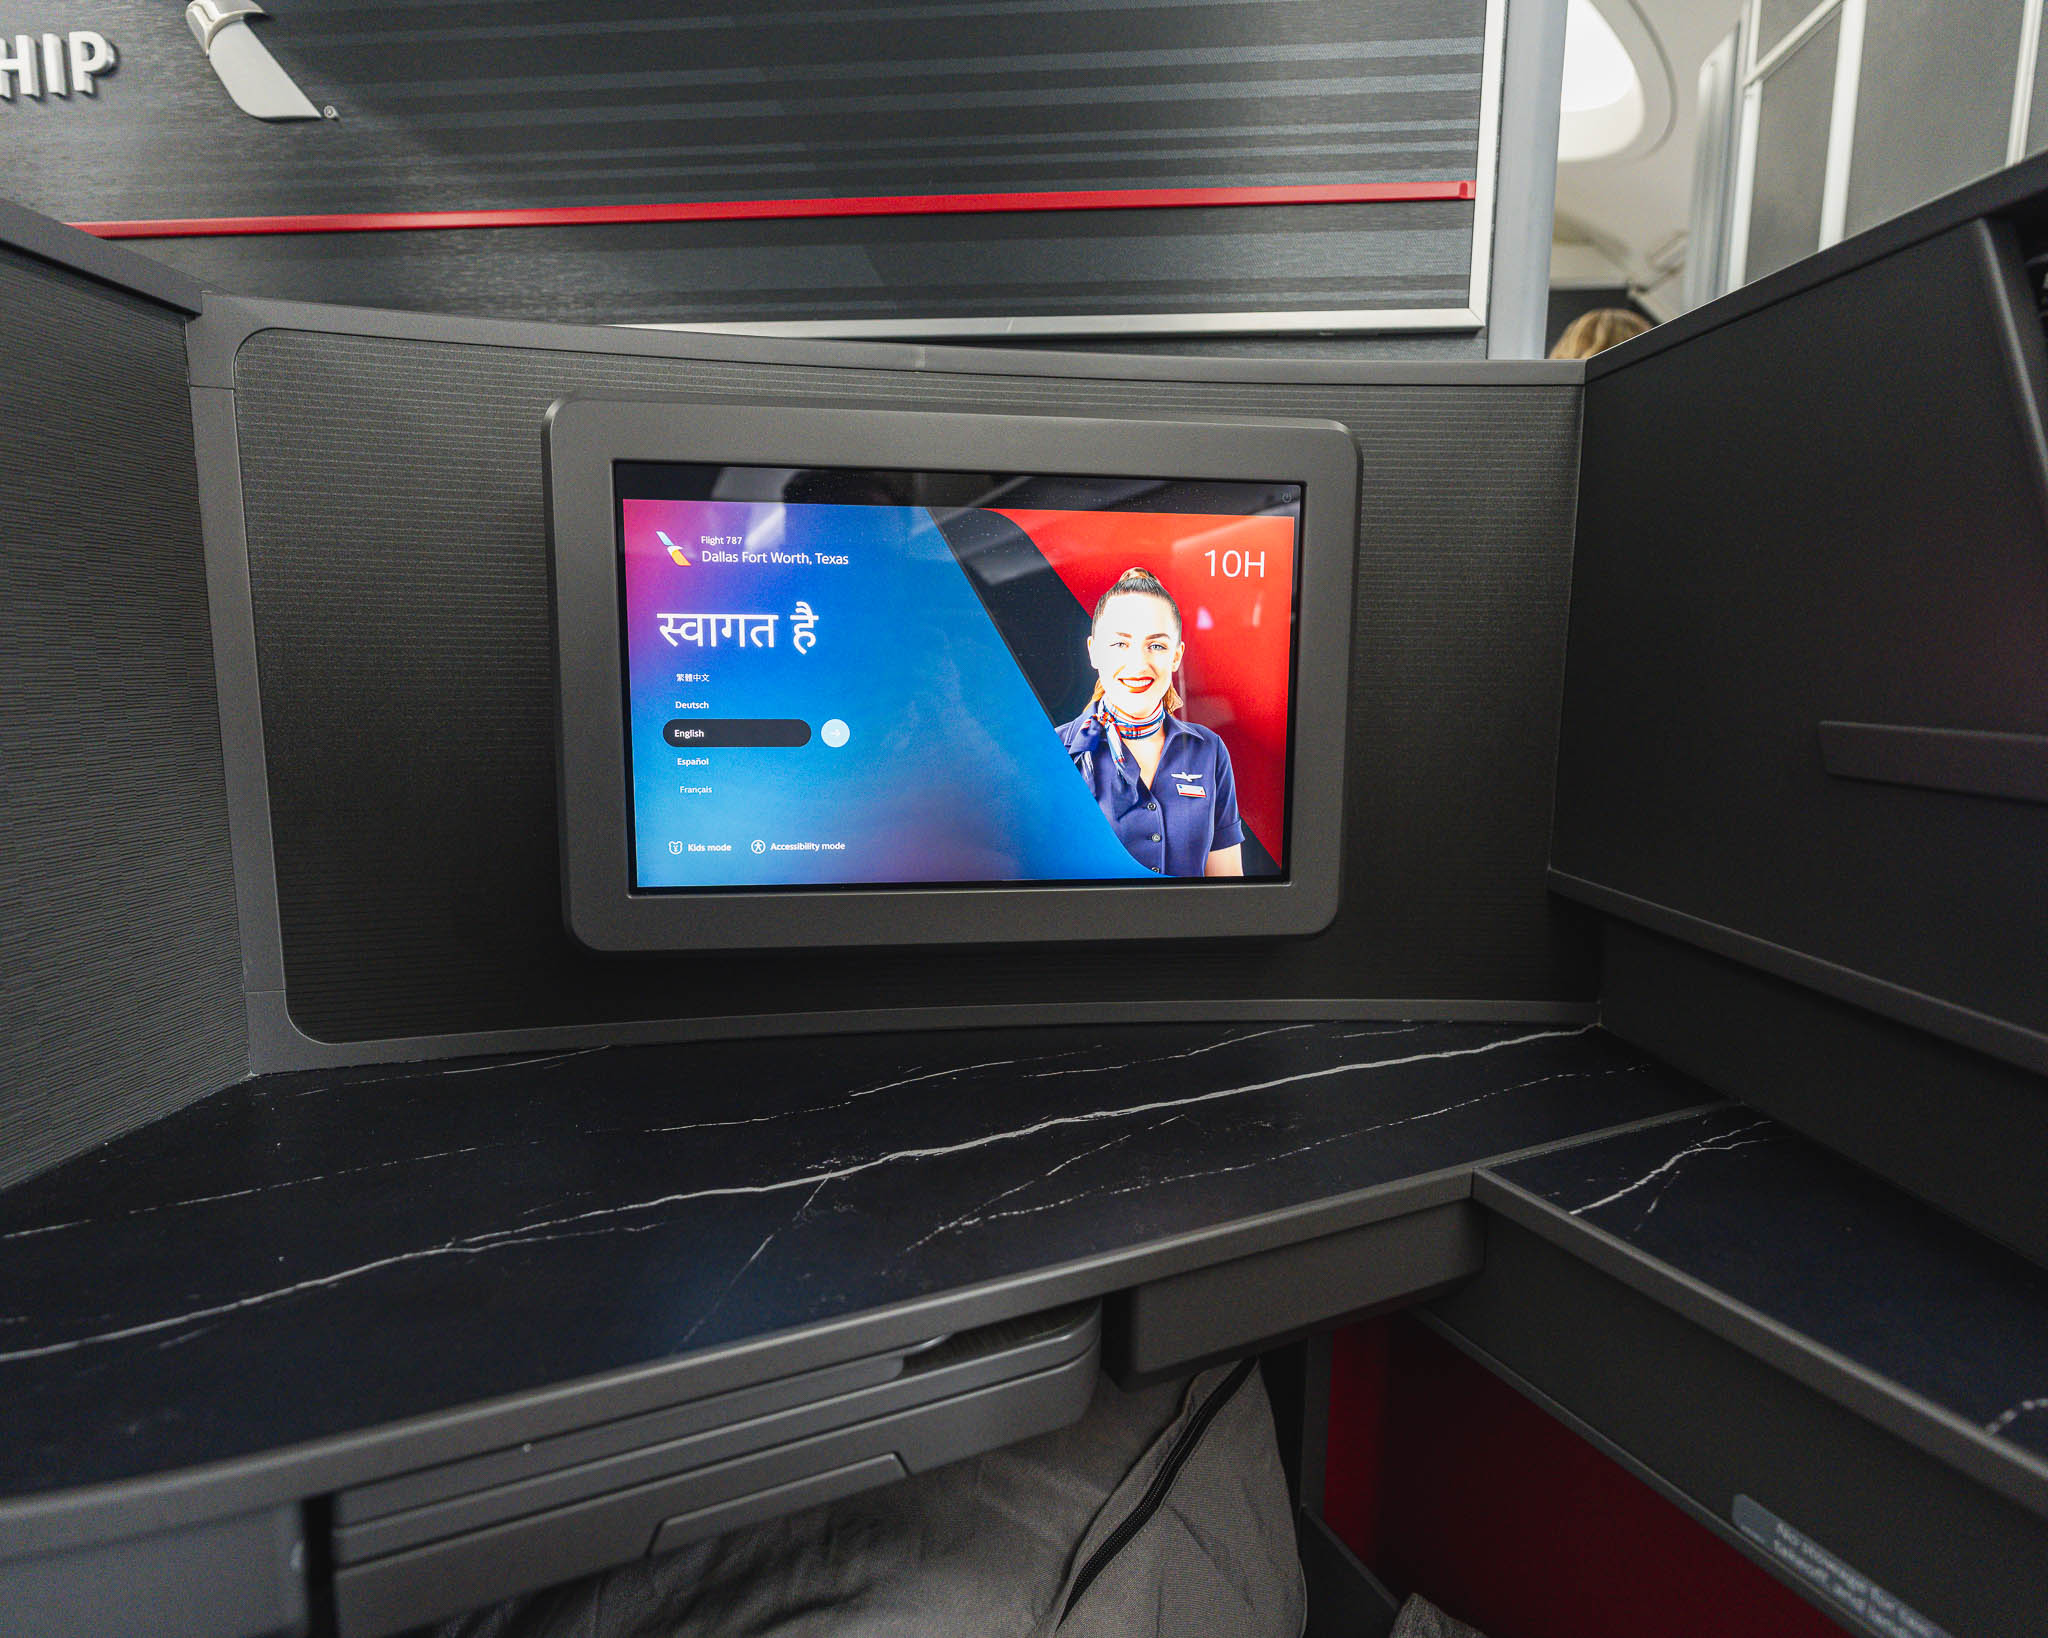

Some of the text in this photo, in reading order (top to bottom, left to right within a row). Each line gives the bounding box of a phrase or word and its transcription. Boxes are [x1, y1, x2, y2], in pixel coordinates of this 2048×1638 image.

[701, 535, 742, 546] Flight 787
[702, 550, 849, 566] Dallas Fort Worth, Texas
[1204, 549, 1266, 578] 10H
[656, 601, 819, 655] स्वागत है
[675, 701, 710, 710] Deutsch
[674, 729, 705, 739] English
[677, 757, 709, 767] Español
[679, 785, 713, 795] Français
[687, 843, 732, 852] Kids mode
[770, 841, 846, 852] Accessibility mode
